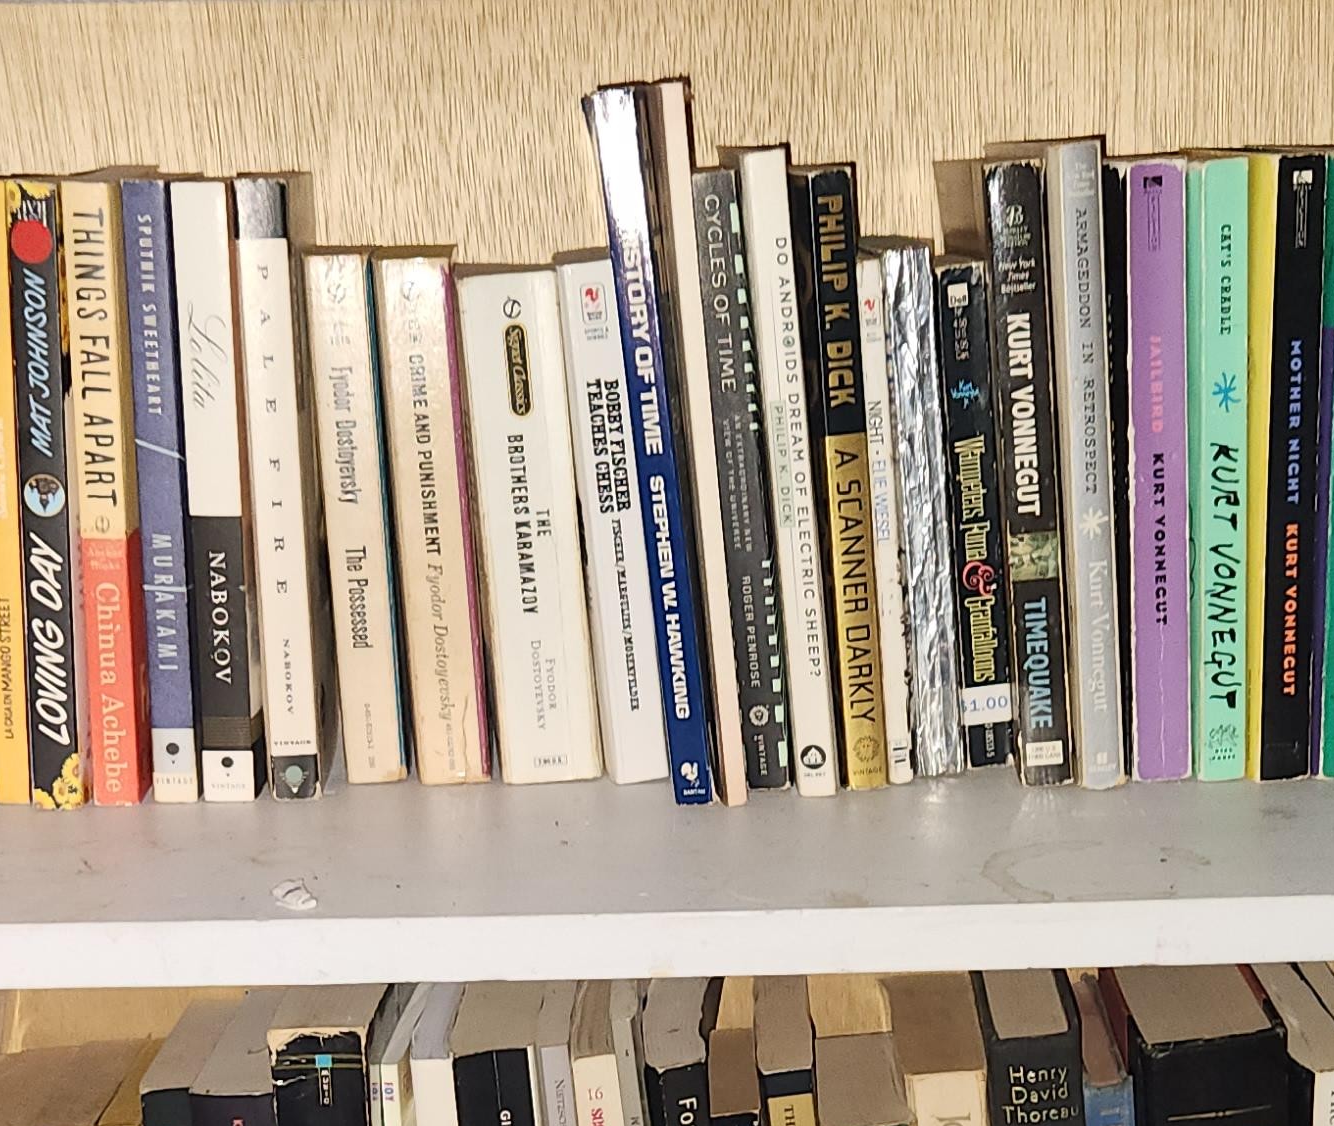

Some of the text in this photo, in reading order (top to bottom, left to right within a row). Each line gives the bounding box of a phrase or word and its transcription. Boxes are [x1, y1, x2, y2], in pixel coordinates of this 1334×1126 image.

[136, 213, 163, 417] SPUTNIK SWEETHEART
[703, 194, 737, 394] CYCLES OF TIME
[817, 195, 857, 408] PHILIP K. DICK
[1219, 224, 1233, 336] CAT'S CRADLE
[23, 267, 54, 457] MAT JOHNSON
[71, 207, 117, 508] THINGS FALL APART
[1005, 311, 1040, 517] KURT VONNEGUT
[1287, 339, 1303, 505] MOTHER NIGHT
[586, 379, 615, 513] TEACHES CHESS
[604, 379, 631, 511] BOBBY FISCHER
[345, 545, 374, 650] The Possessed
[507, 434, 539, 614] BROTHERS KARAMAZOV
[647, 475, 676, 579] STEPHEN
[665, 612, 691, 720] HAWKING
[834, 448, 876, 724] A SCANNER DARKLY
[29, 532, 71, 747] LOVING DAY
[150, 532, 179, 672] MURAKAMI
[208, 551, 233, 686] NABOKOV
[282, 638, 295, 716] NABOKOV
[742, 575, 761, 688] ROGER PENROSE
[1023, 597, 1054, 729] TIMEQUAKE
[94, 581, 130, 794] Chinua Achebe
[1001, 1103, 1080, 1125] Thoreau
[1009, 1065, 1067, 1086] Henry
[1010, 1084, 1068, 1105] David
